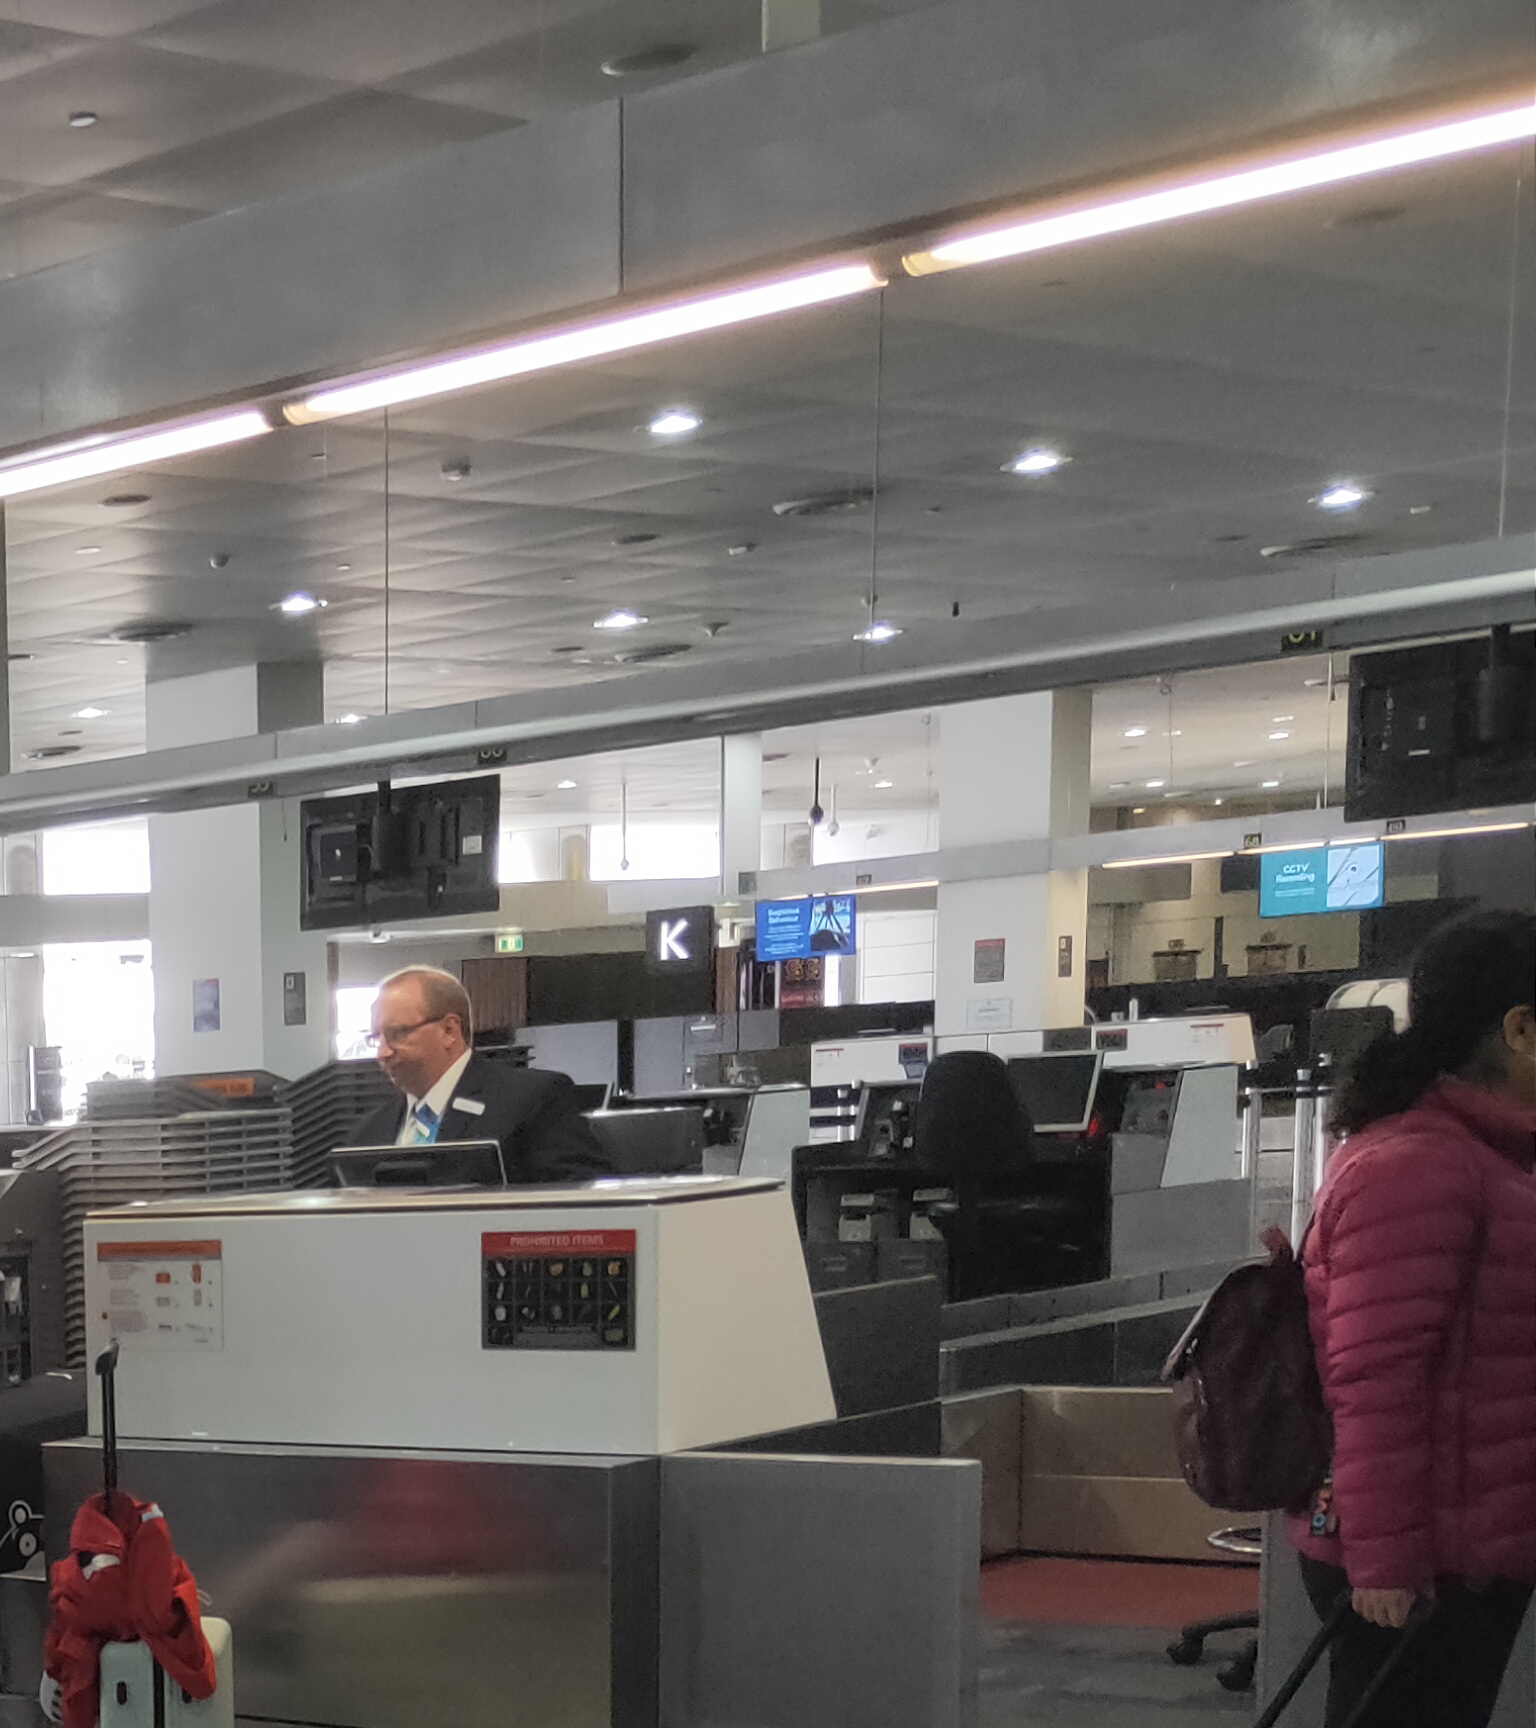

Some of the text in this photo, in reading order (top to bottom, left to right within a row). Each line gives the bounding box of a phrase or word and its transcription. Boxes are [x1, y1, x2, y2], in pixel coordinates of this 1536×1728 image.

[1283, 862, 1310, 875] CCTV
[660, 918, 689, 961] K
[572, 1234, 604, 1246] ITEMS
